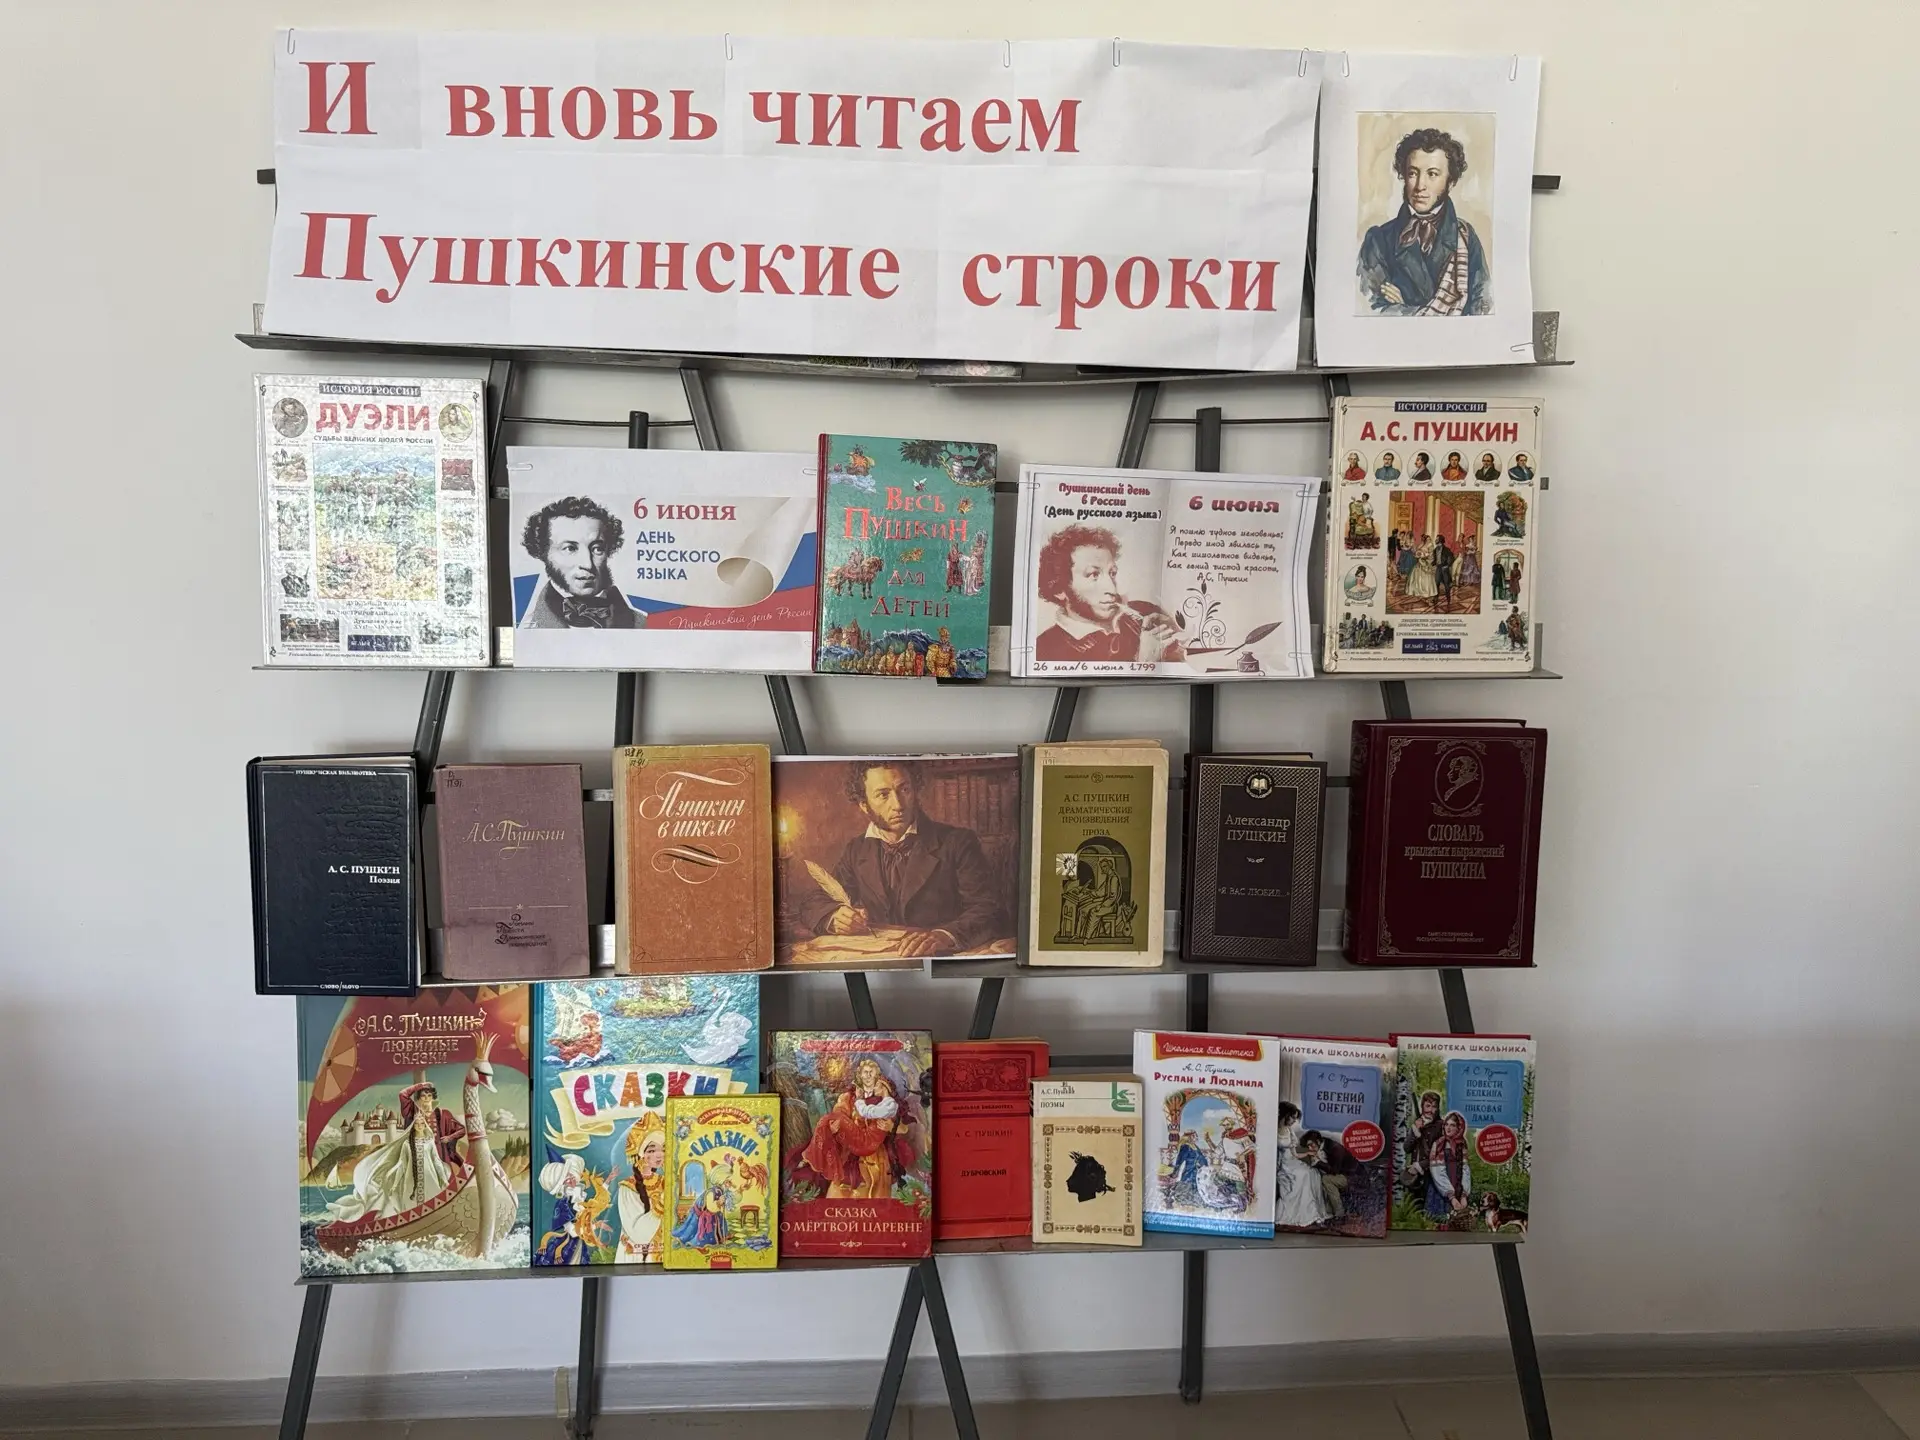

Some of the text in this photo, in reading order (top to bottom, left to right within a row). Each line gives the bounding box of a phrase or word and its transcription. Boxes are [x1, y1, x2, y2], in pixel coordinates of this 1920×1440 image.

[299, 61, 1081, 154] И вновь читаем
[294, 211, 1281, 330] Пушкинские строки
[322, 384, 420, 397] ИСТОРИЯ РОССИИ
[1397, 402, 1485, 412] ИСТОРИЯ РОССИИ
[315, 402, 430, 433] ДУЭЛИ
[1413, 421, 1519, 442] ПУШКИН
[1058, 482, 1151, 496] Пушкинский день
[1081, 494, 1126, 506] в России
[1189, 496, 1280, 513] 6 июня
[633, 497, 736, 521] 6 июня
[1044, 505, 1162, 522] (День русского языка)
[1169, 525, 1177, 535] Я
[636, 531, 676, 545] ДЕНЬ
[1174, 536, 1202, 550] Передо
[636, 549, 720, 563] РУССКОГО
[1171, 548, 1187, 558] Как
[1167, 560, 1182, 569] Как
[636, 567, 687, 581] ЯЗЫКА
[888, 569, 925, 586] ДЛЯ
[1217, 572, 1248, 586] Пушкин
[870, 596, 950, 617] ДЕТЕЙ
[669, 609, 746, 629] Пушкинский
[747, 613, 773, 628] день
[1033, 662, 1048, 671] 26
[1129, 663, 1156, 671] 1799
[639, 768, 746, 820] Пушкин
[1083, 793, 1130, 803] ПУШКИН
[1058, 806, 1133, 815] ДРАМАТИЧЕСКИЕ
[1062, 816, 1130, 824] ПРОИЗВЕДЕНИЯ
[1224, 813, 1291, 829] Александр
[657, 818, 736, 838] в школе
[1082, 828, 1111, 837] ПРОЗА
[1427, 824, 1484, 842] СЛОВАРЬ
[1226, 829, 1287, 843] ПУШКИН
[351, 865, 400, 875] ПУШКИН
[1420, 861, 1487, 879] ПУШКИНА
[369, 875, 400, 884] Поэзия
[381, 1039, 459, 1053] ЛЮБИМЫЕ
[1163, 1042, 1254, 1057] Школьная библиотека
[1407, 1043, 1527, 1053] БИБЛИОТЕКА ШКОЛЬНИКА
[392, 1052, 448, 1065] СКАЗКИ
[1327, 1049, 1387, 1060] ШКОЛЬНИКА
[1204, 1064, 1236, 1075] Пушкин
[1466, 1080, 1503, 1088] ПОВЕСТИ
[573, 1071, 719, 1116] СКАЗКИ
[1316, 1091, 1365, 1104] ЕВГЕНИЙ
[1466, 1089, 1503, 1098] БЕЛКИНА
[1318, 1102, 1363, 1115] ОНЕГИН
[1465, 1104, 1503, 1113] ПИКОВАЯ
[1471, 1114, 1495, 1122] ДАМА
[975, 1129, 1013, 1139] ПУШКИН
[690, 1130, 758, 1157] СКАЗКИ
[960, 1168, 1007, 1177] ДУБРОВСКИЙ
[824, 1207, 878, 1218] СКАЗКА
[780, 1222, 791, 1232] О
[862, 1222, 923, 1233] ЦАРЕВНЕ
